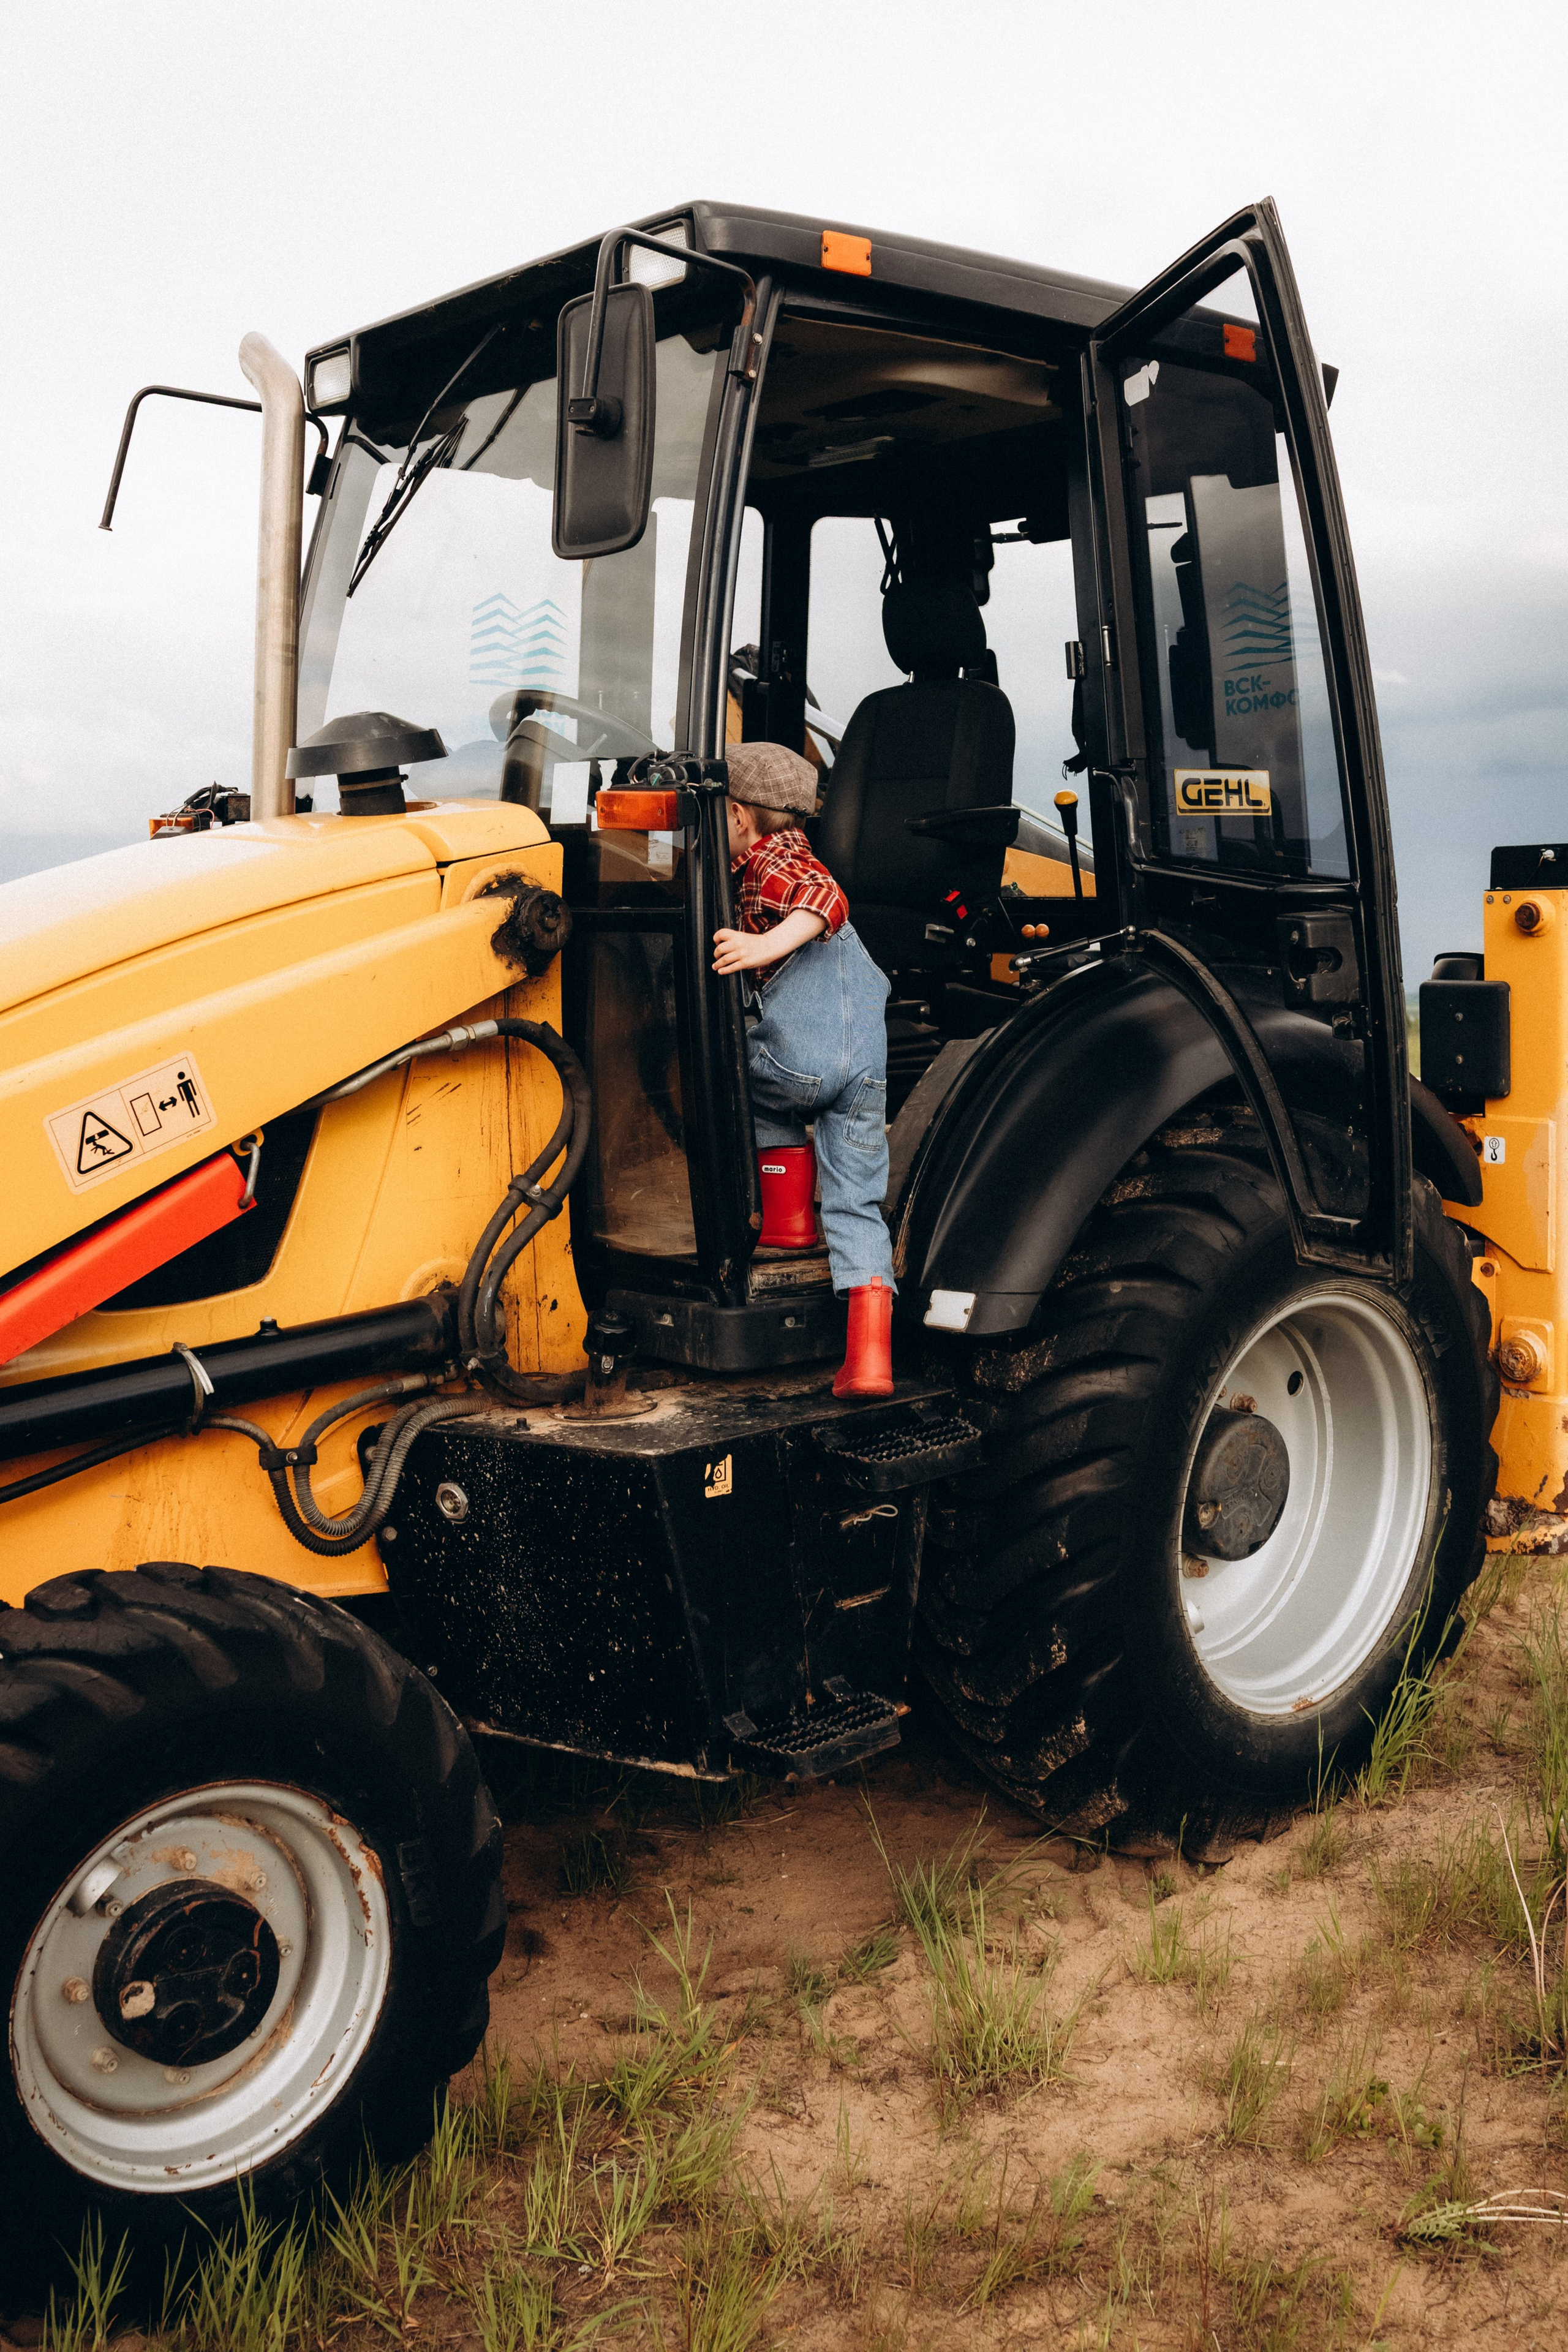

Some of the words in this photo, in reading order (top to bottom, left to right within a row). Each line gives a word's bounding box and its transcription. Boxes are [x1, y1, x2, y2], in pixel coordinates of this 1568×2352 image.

[1224, 674, 1272, 697] ВСК-
[1226, 688, 1300, 717] КОМФО
[1182, 777, 1263, 807] GEHL
